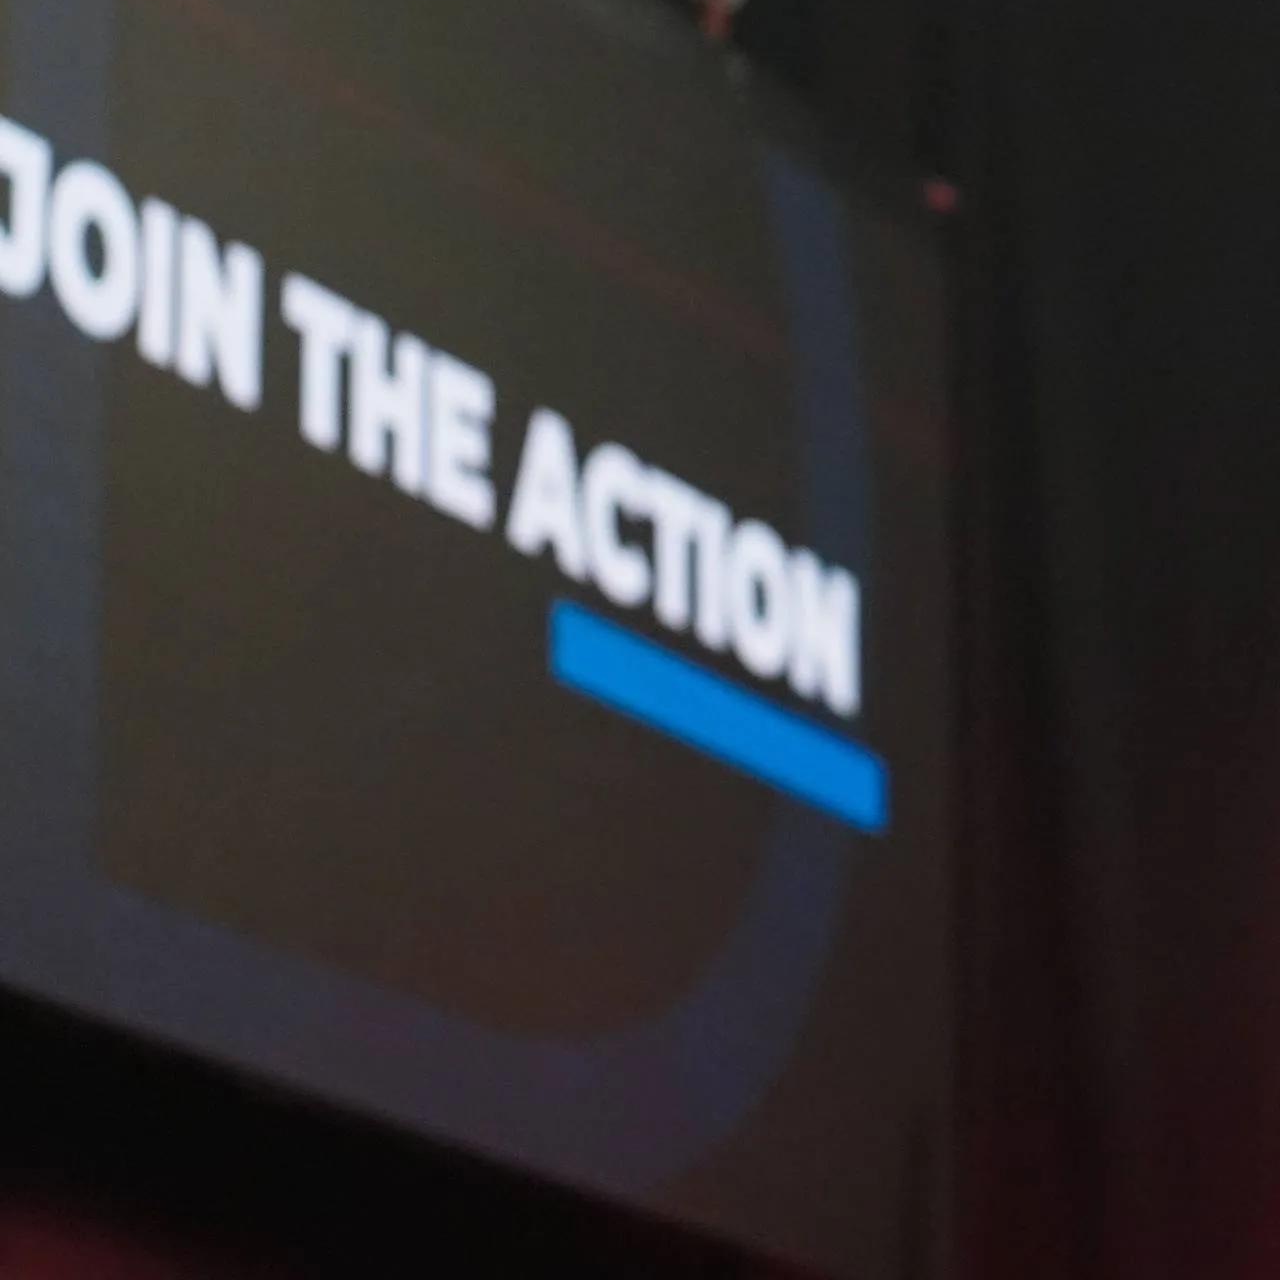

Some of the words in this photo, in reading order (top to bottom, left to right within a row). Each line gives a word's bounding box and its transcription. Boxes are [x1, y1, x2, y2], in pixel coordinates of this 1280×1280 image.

[0, 116, 264, 412] JOIN
[281, 270, 497, 531] THE
[507, 406, 861, 718] ACTION
